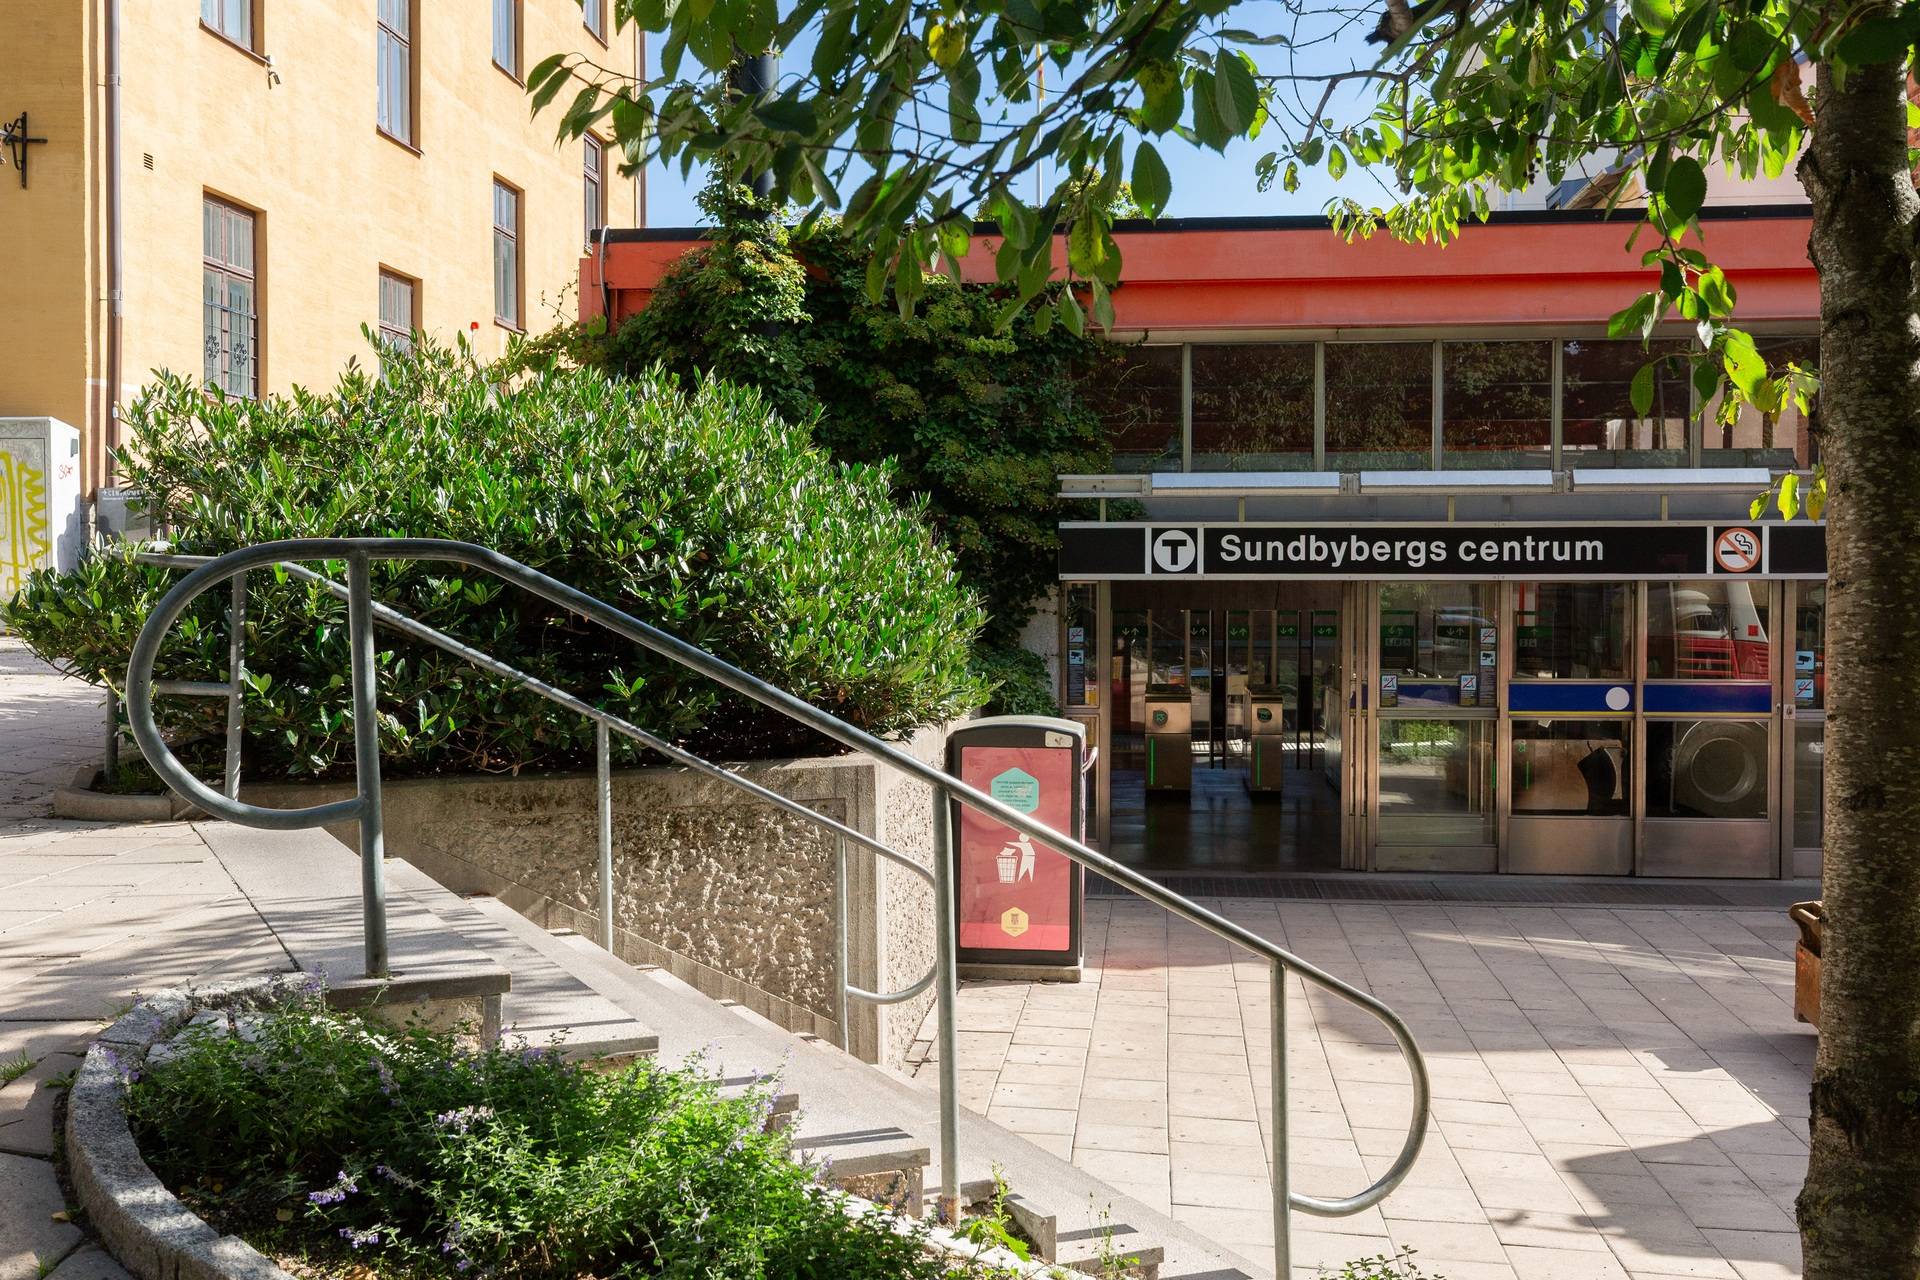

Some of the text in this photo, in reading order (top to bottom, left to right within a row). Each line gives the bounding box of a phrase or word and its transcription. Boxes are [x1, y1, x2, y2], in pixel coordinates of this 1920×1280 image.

[1161, 539, 1188, 566] T
[1219, 534, 1604, 568] Sundbybergs centrum
